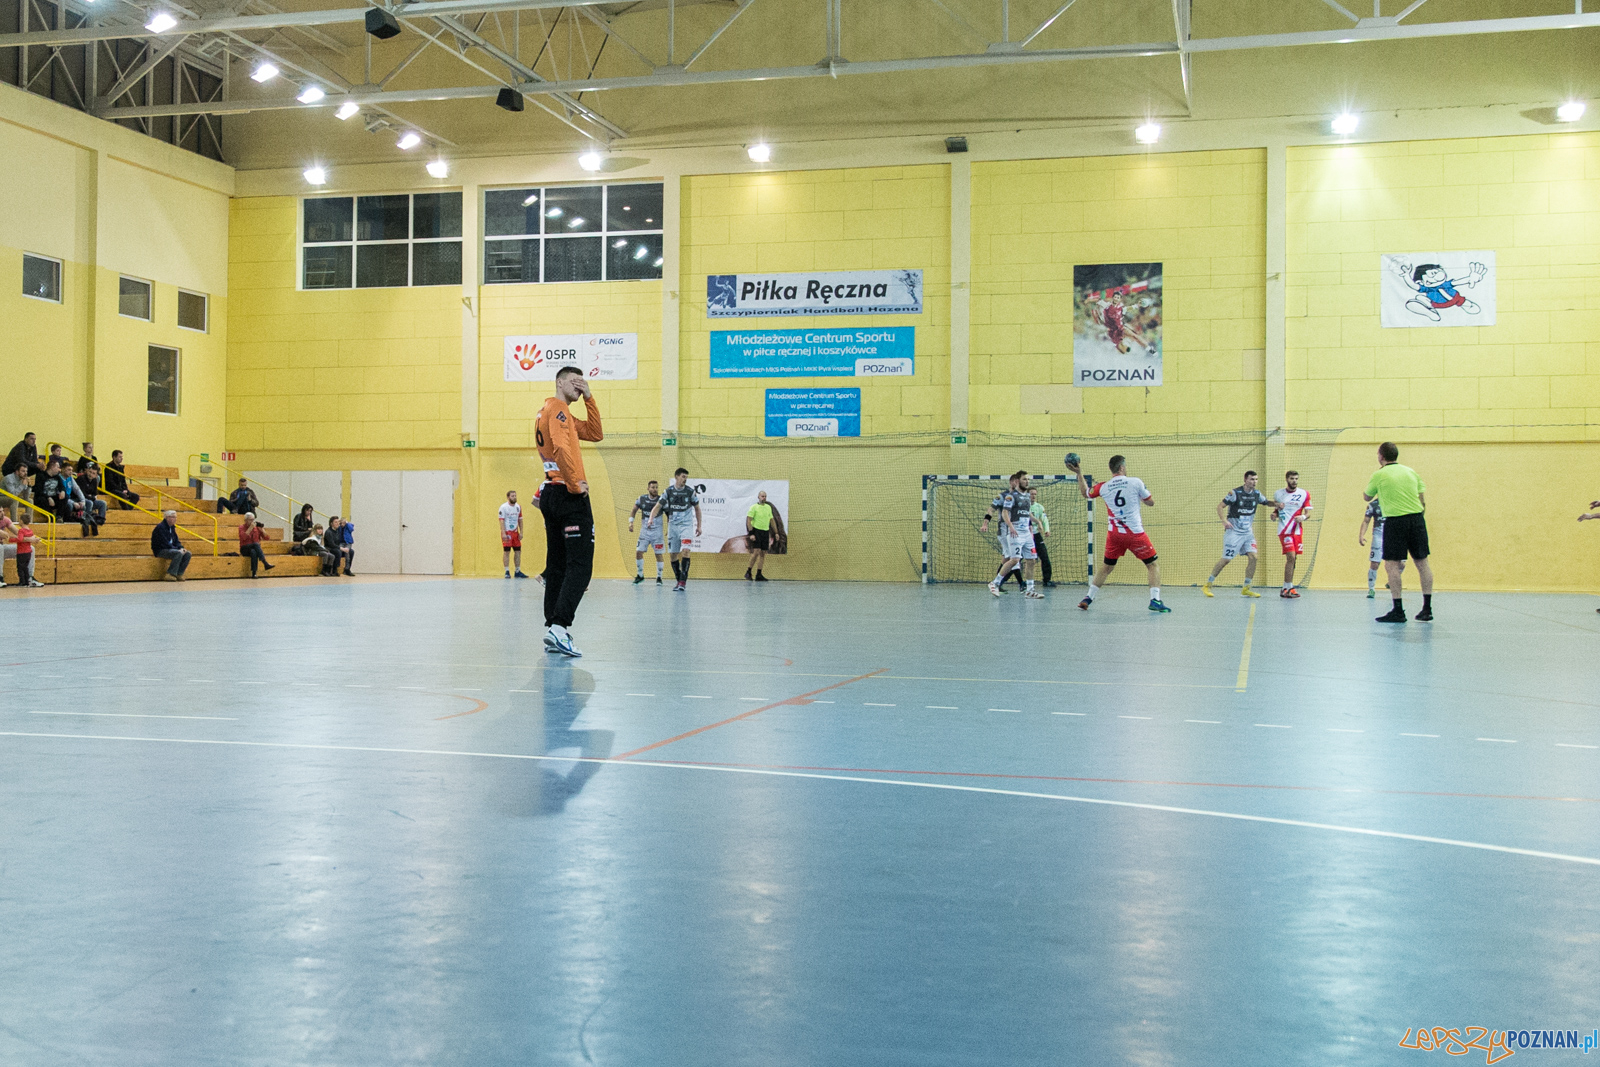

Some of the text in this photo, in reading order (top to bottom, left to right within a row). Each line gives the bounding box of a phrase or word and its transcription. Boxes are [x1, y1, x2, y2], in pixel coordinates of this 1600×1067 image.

[741, 280, 888, 304] Piłka Ręczna
[711, 309, 799, 317] Szczypiorniak
[726, 332, 896, 345] Młodzieżowe Centrum Sportu
[546, 349, 576, 360] OSPR
[753, 347, 776, 358] piłce
[777, 347, 811, 357] ręcznej
[812, 346, 816, 355] i
[817, 345, 878, 356] koszykówce
[1081, 365, 1155, 381] POZNAŃ
[1114, 490, 1126, 507] 6
[1291, 494, 1302, 502] 22
